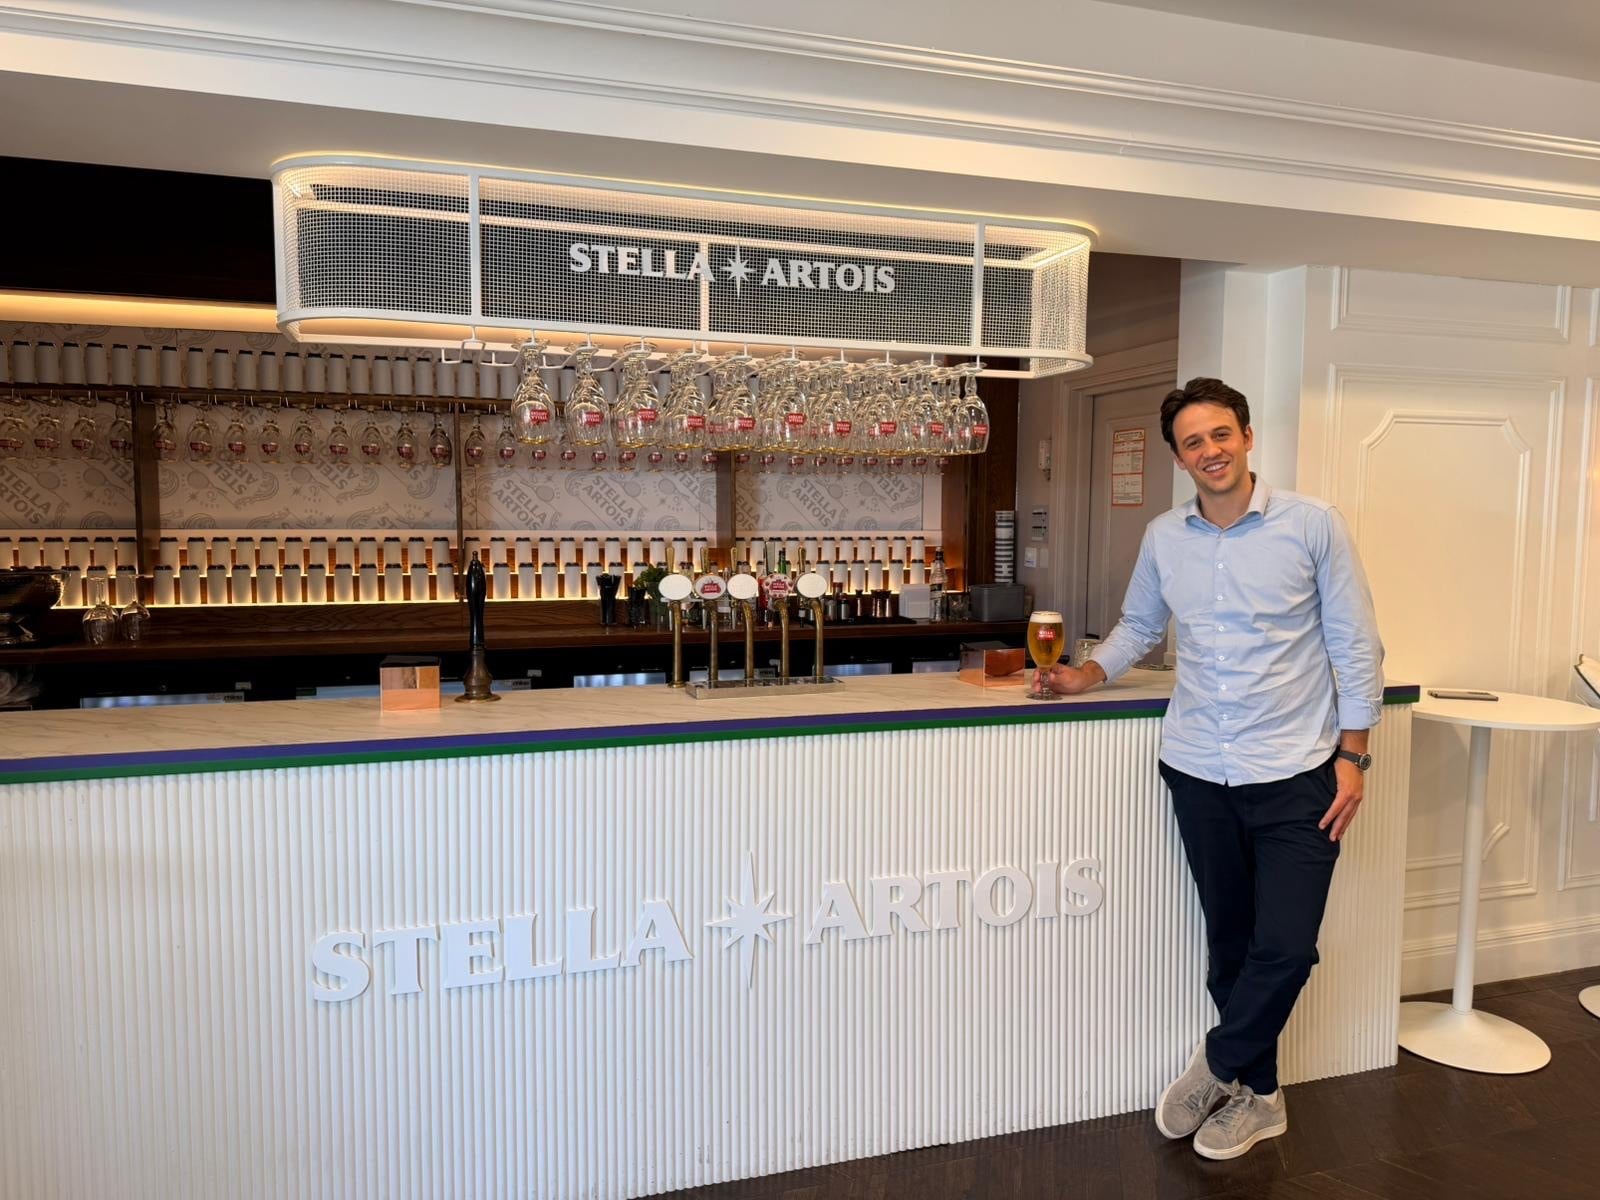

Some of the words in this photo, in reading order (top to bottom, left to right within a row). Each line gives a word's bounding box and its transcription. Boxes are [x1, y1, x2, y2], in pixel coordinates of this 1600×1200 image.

[568, 243, 716, 282] STELLA
[760, 258, 896, 294] ARTOIS
[0, 482, 43, 524] RTOIS
[493, 488, 542, 531] ARTOIS
[502, 479, 548, 525] STELLA
[582, 484, 629, 527] ARTOIS
[592, 475, 635, 518] STELLA
[736, 495, 760, 524] ELLA
[792, 488, 832, 528] ARTOIS
[801, 479, 837, 520] STELLA
[312, 900, 694, 1003] STELLA
[804, 857, 1106, 946] ARTOIS
